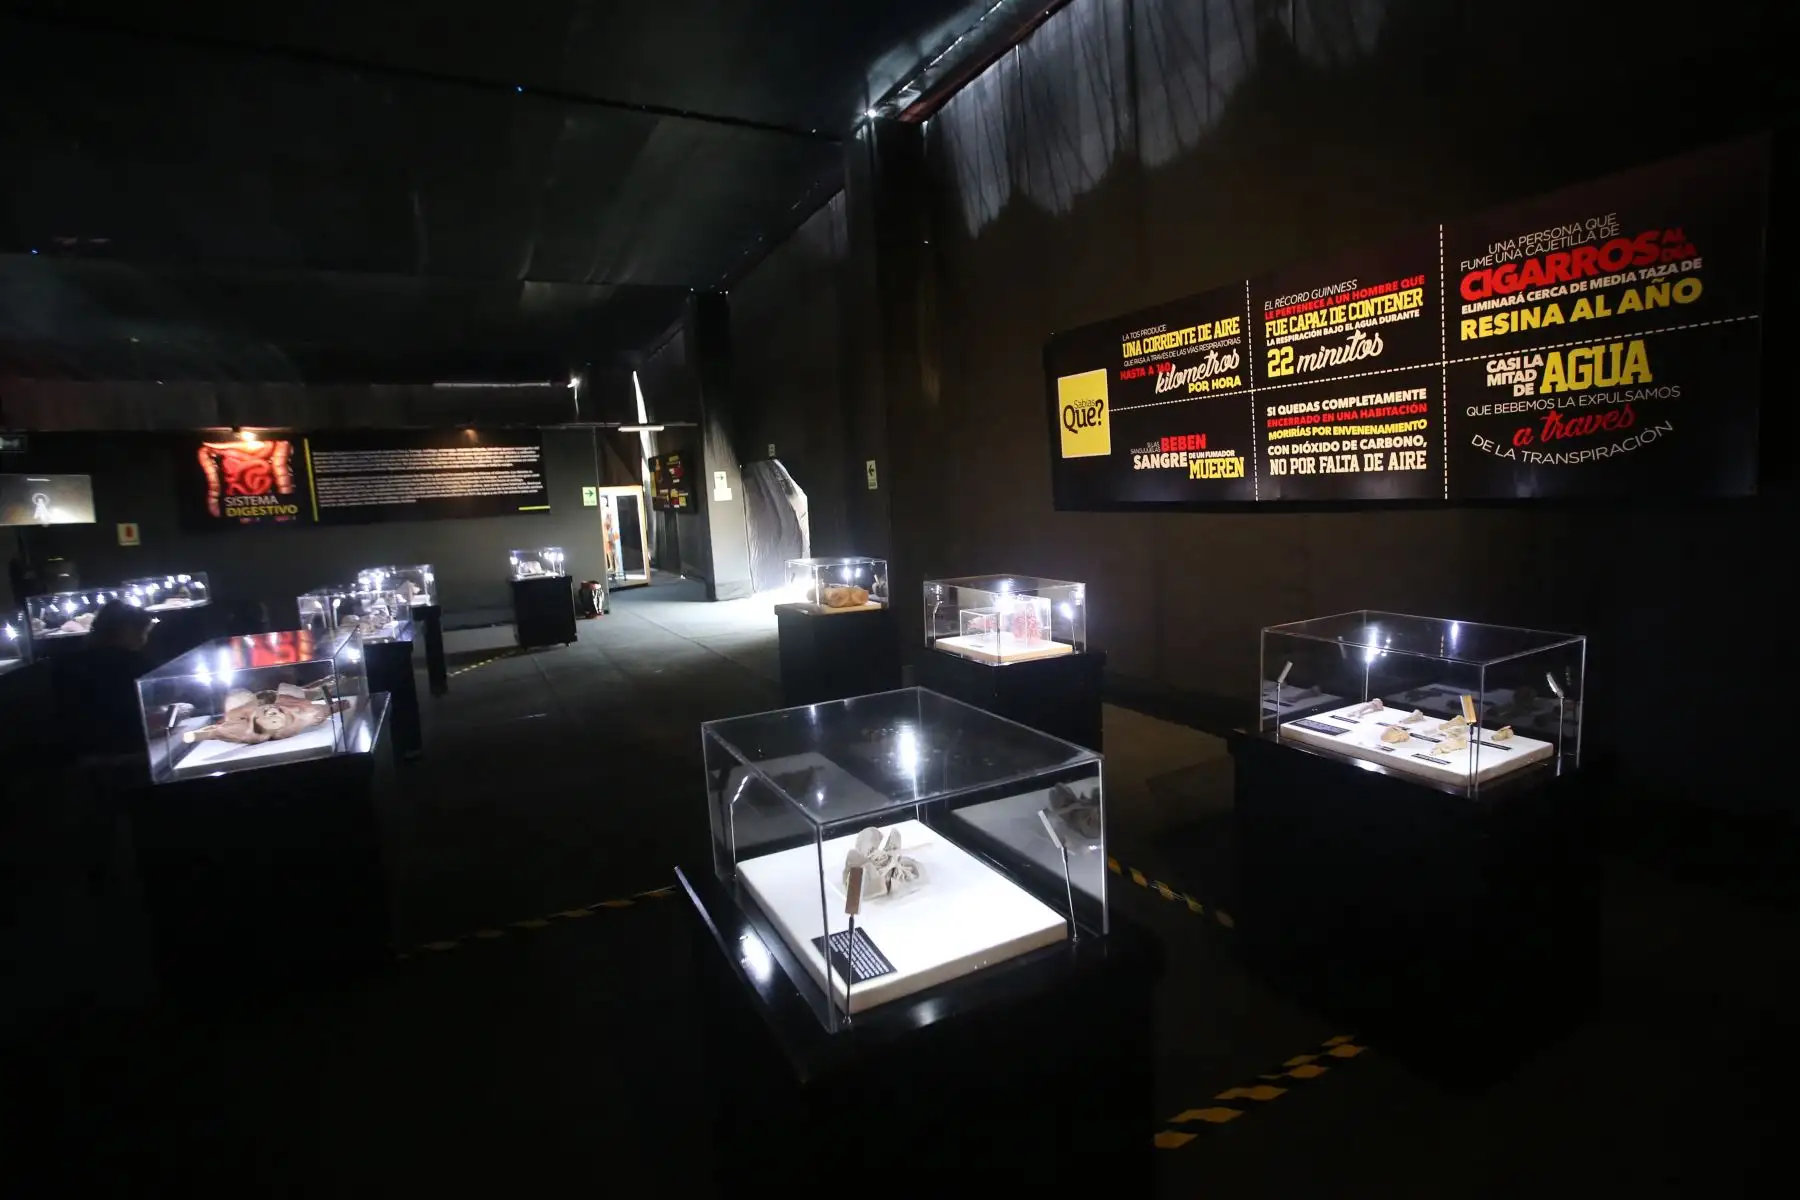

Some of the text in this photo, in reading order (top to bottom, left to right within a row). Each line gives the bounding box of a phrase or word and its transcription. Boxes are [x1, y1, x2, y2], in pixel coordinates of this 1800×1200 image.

[1460, 223, 1620, 272] FUME UNA CAJETILLA DE
[1488, 212, 1617, 255] UNA PERSONA QUE
[1460, 230, 1661, 301] CIGARROS
[1264, 279, 1358, 311] EL RÉCORD GUINNESS
[1265, 274, 1425, 320] LE PERTENECE A UN HOMBRE QUE
[1461, 258, 1703, 315] ELIMINARÁ CERCA DE MEDIA TAZA DE
[1265, 287, 1424, 338] FUE CAPAZ DE CONTENER
[1460, 276, 1703, 341] RESINA AL AÑO
[1122, 316, 1240, 358] UNA CORRIENTE DE AIRE
[1140, 324, 1167, 338] PRODUCE
[1266, 308, 1420, 347] LA RESPIRACIÓN BAJO EL AGUA DURANTE
[1267, 329, 1384, 378] 22 minutos
[1486, 353, 1544, 374] CASI LA
[1539, 339, 1652, 394] AGUA
[1120, 366, 1146, 380] HASTA
[1148, 365, 1155, 375] A
[1155, 348, 1240, 395] kilometros
[1188, 375, 1242, 394] POR HORA
[1486, 369, 1537, 387] MITAD
[1267, 388, 1427, 416] SI QUEDAS COMPLETAMENTE
[1466, 386, 1681, 417] QUE BEBEMOS LA EXPULSAMOS
[1513, 382, 1534, 397] DE
[1063, 399, 1104, 434] Que?
[1267, 403, 1428, 428] ENCERRADO EN UNA HABITACIÓN
[1268, 419, 1428, 441] MORIRÍAS POR ENVENENAMIENTO
[1512, 403, 1637, 447] a traves
[1160, 433, 1207, 452] BEBEN
[1205, 450, 1235, 458] FUMADOR
[1267, 434, 1428, 456] CON DIÓXIDO DE CARBONO,
[1471, 420, 1674, 465] DE LA TRANSPIRACIÓN
[1133, 452, 1188, 470] SANGRE
[1189, 457, 1245, 480] MUEREN
[1269, 450, 1427, 476] NO POR FALTA DE AIRE
[224, 495, 279, 507] SISTEMA
[225, 504, 298, 517] DIGESTIVO
